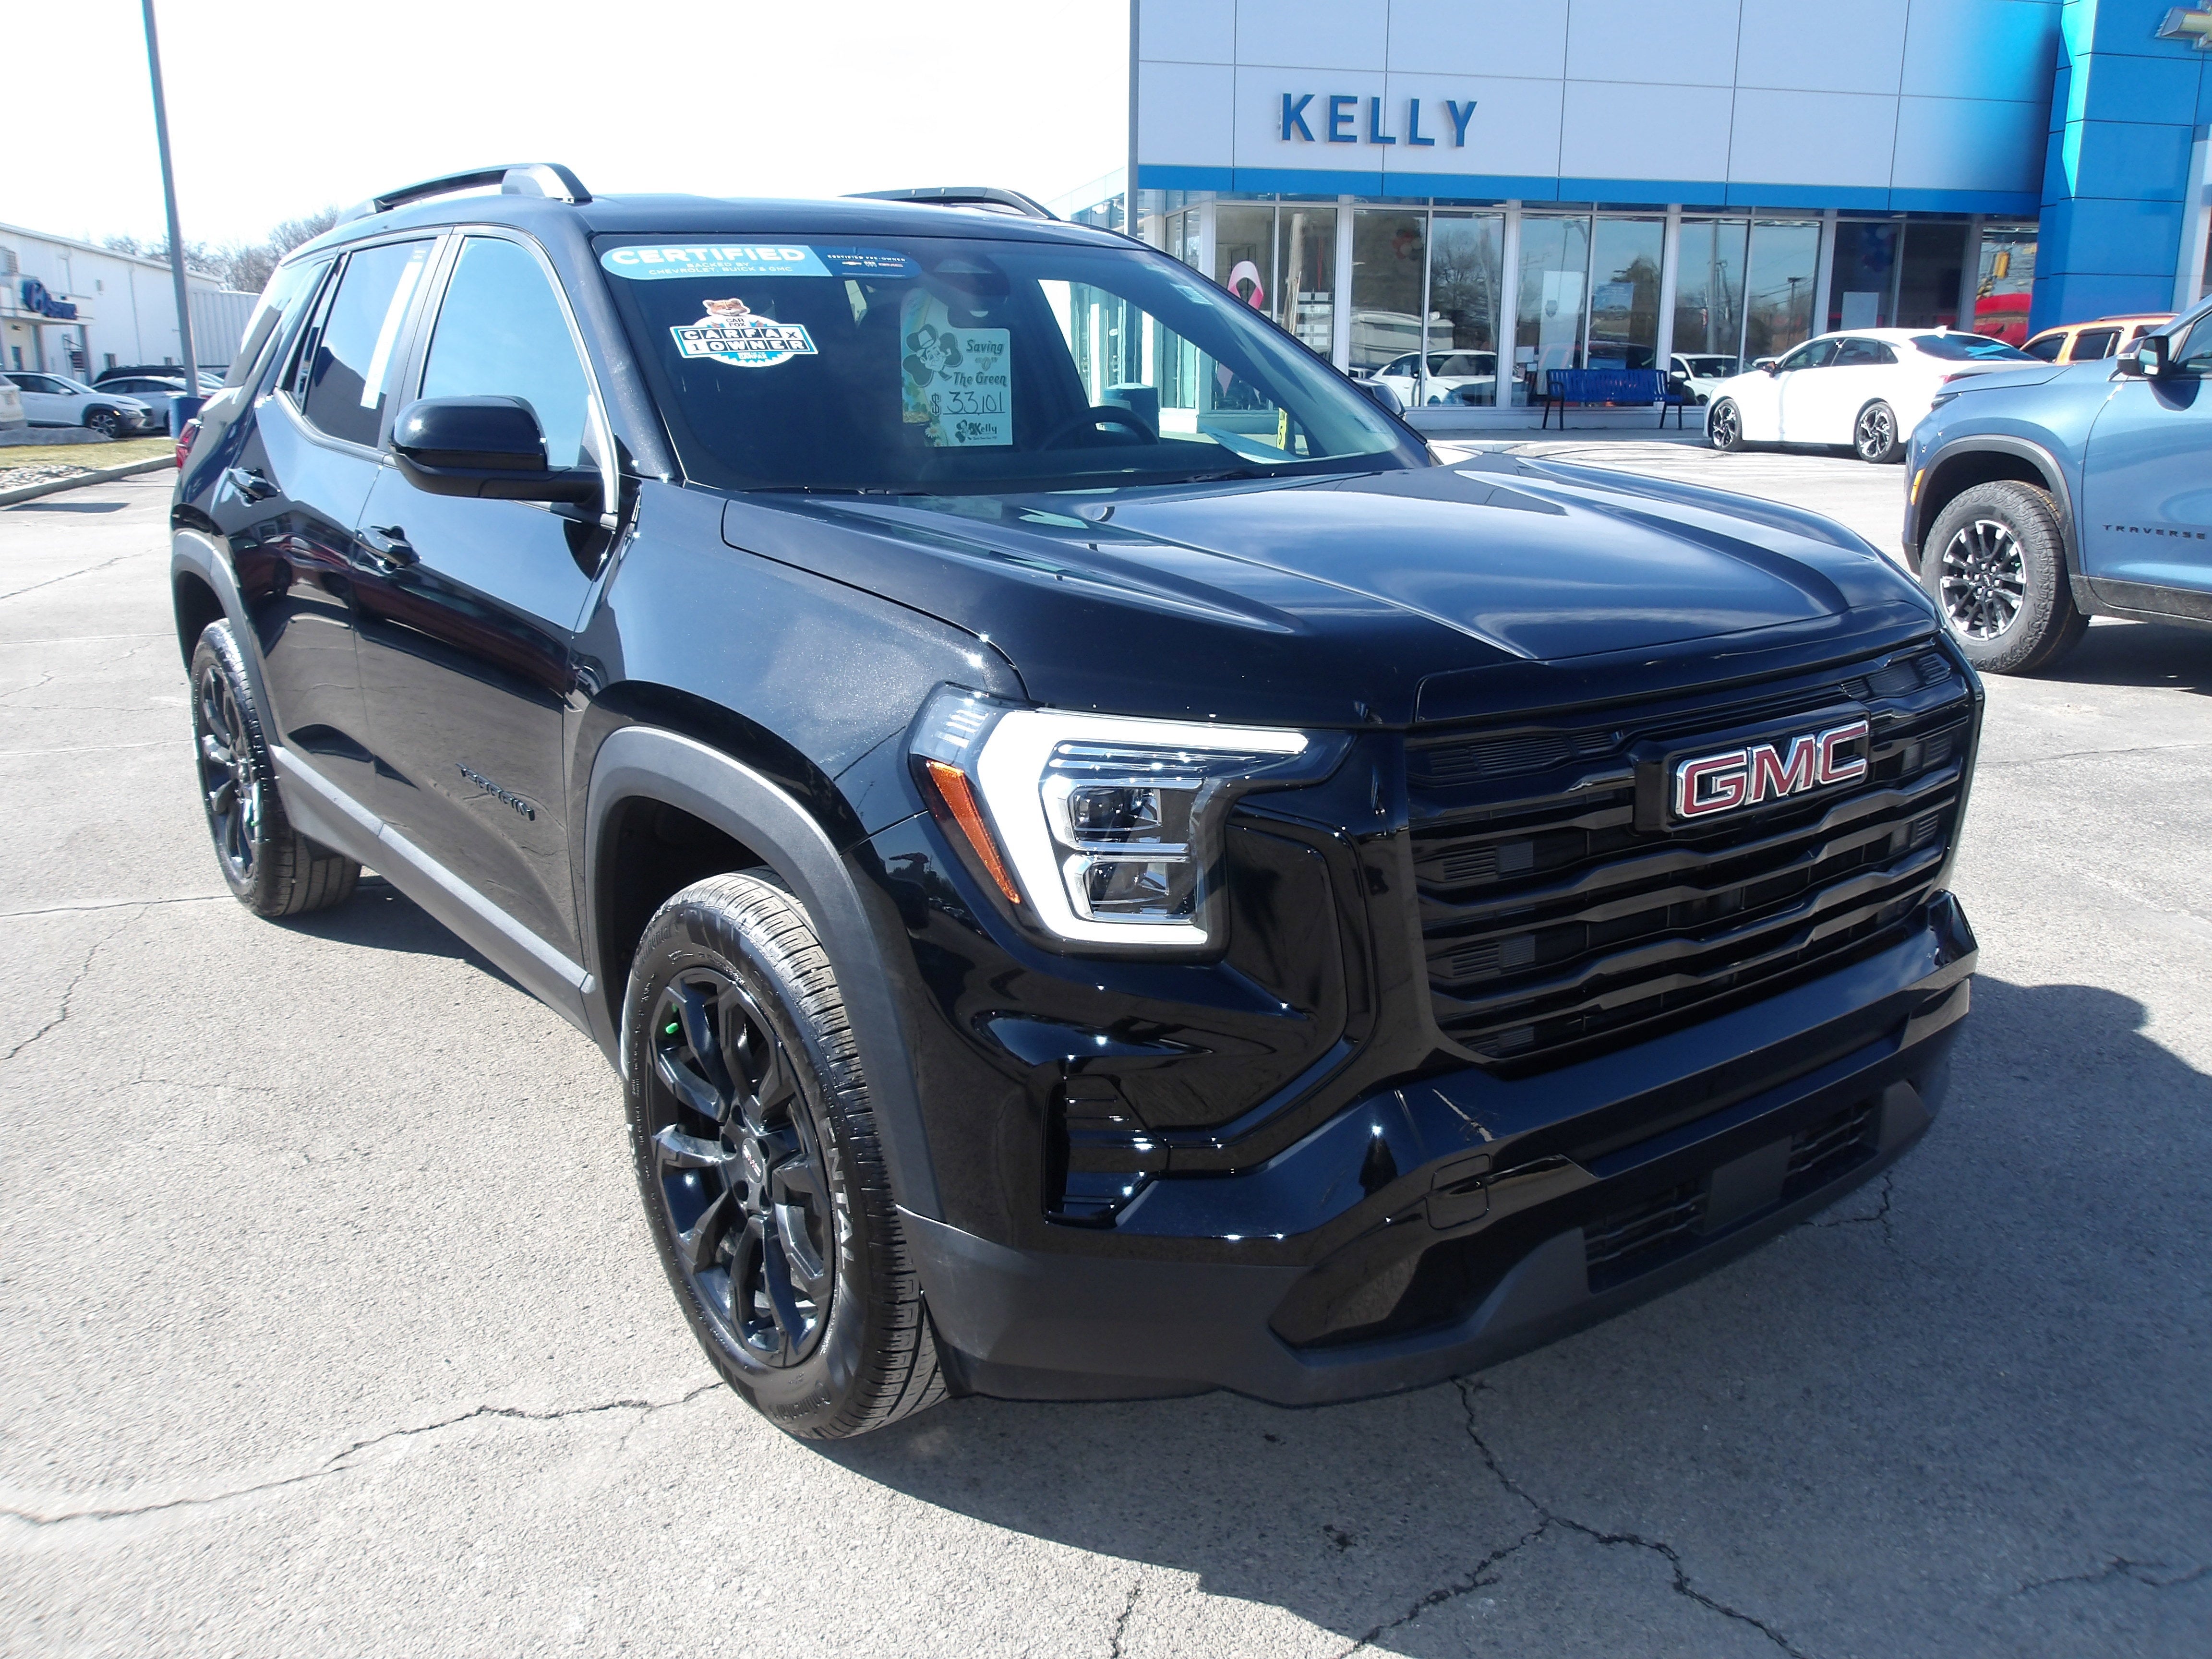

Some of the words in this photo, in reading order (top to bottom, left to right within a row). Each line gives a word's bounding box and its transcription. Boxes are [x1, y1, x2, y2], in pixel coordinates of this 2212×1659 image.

[1281, 93, 1478, 147] KELLY
[611, 247, 805, 265] CERTIFIED
[683, 328, 797, 340] CARFAX
[691, 343, 703, 351] 1
[709, 340, 805, 352] OWNER
[966, 339, 1004, 355] Saving
[953, 372, 974, 387] The
[975, 371, 1008, 387] Green
[2103, 524, 2206, 540] TRAVERSE
[1675, 720, 1869, 818] GMC
